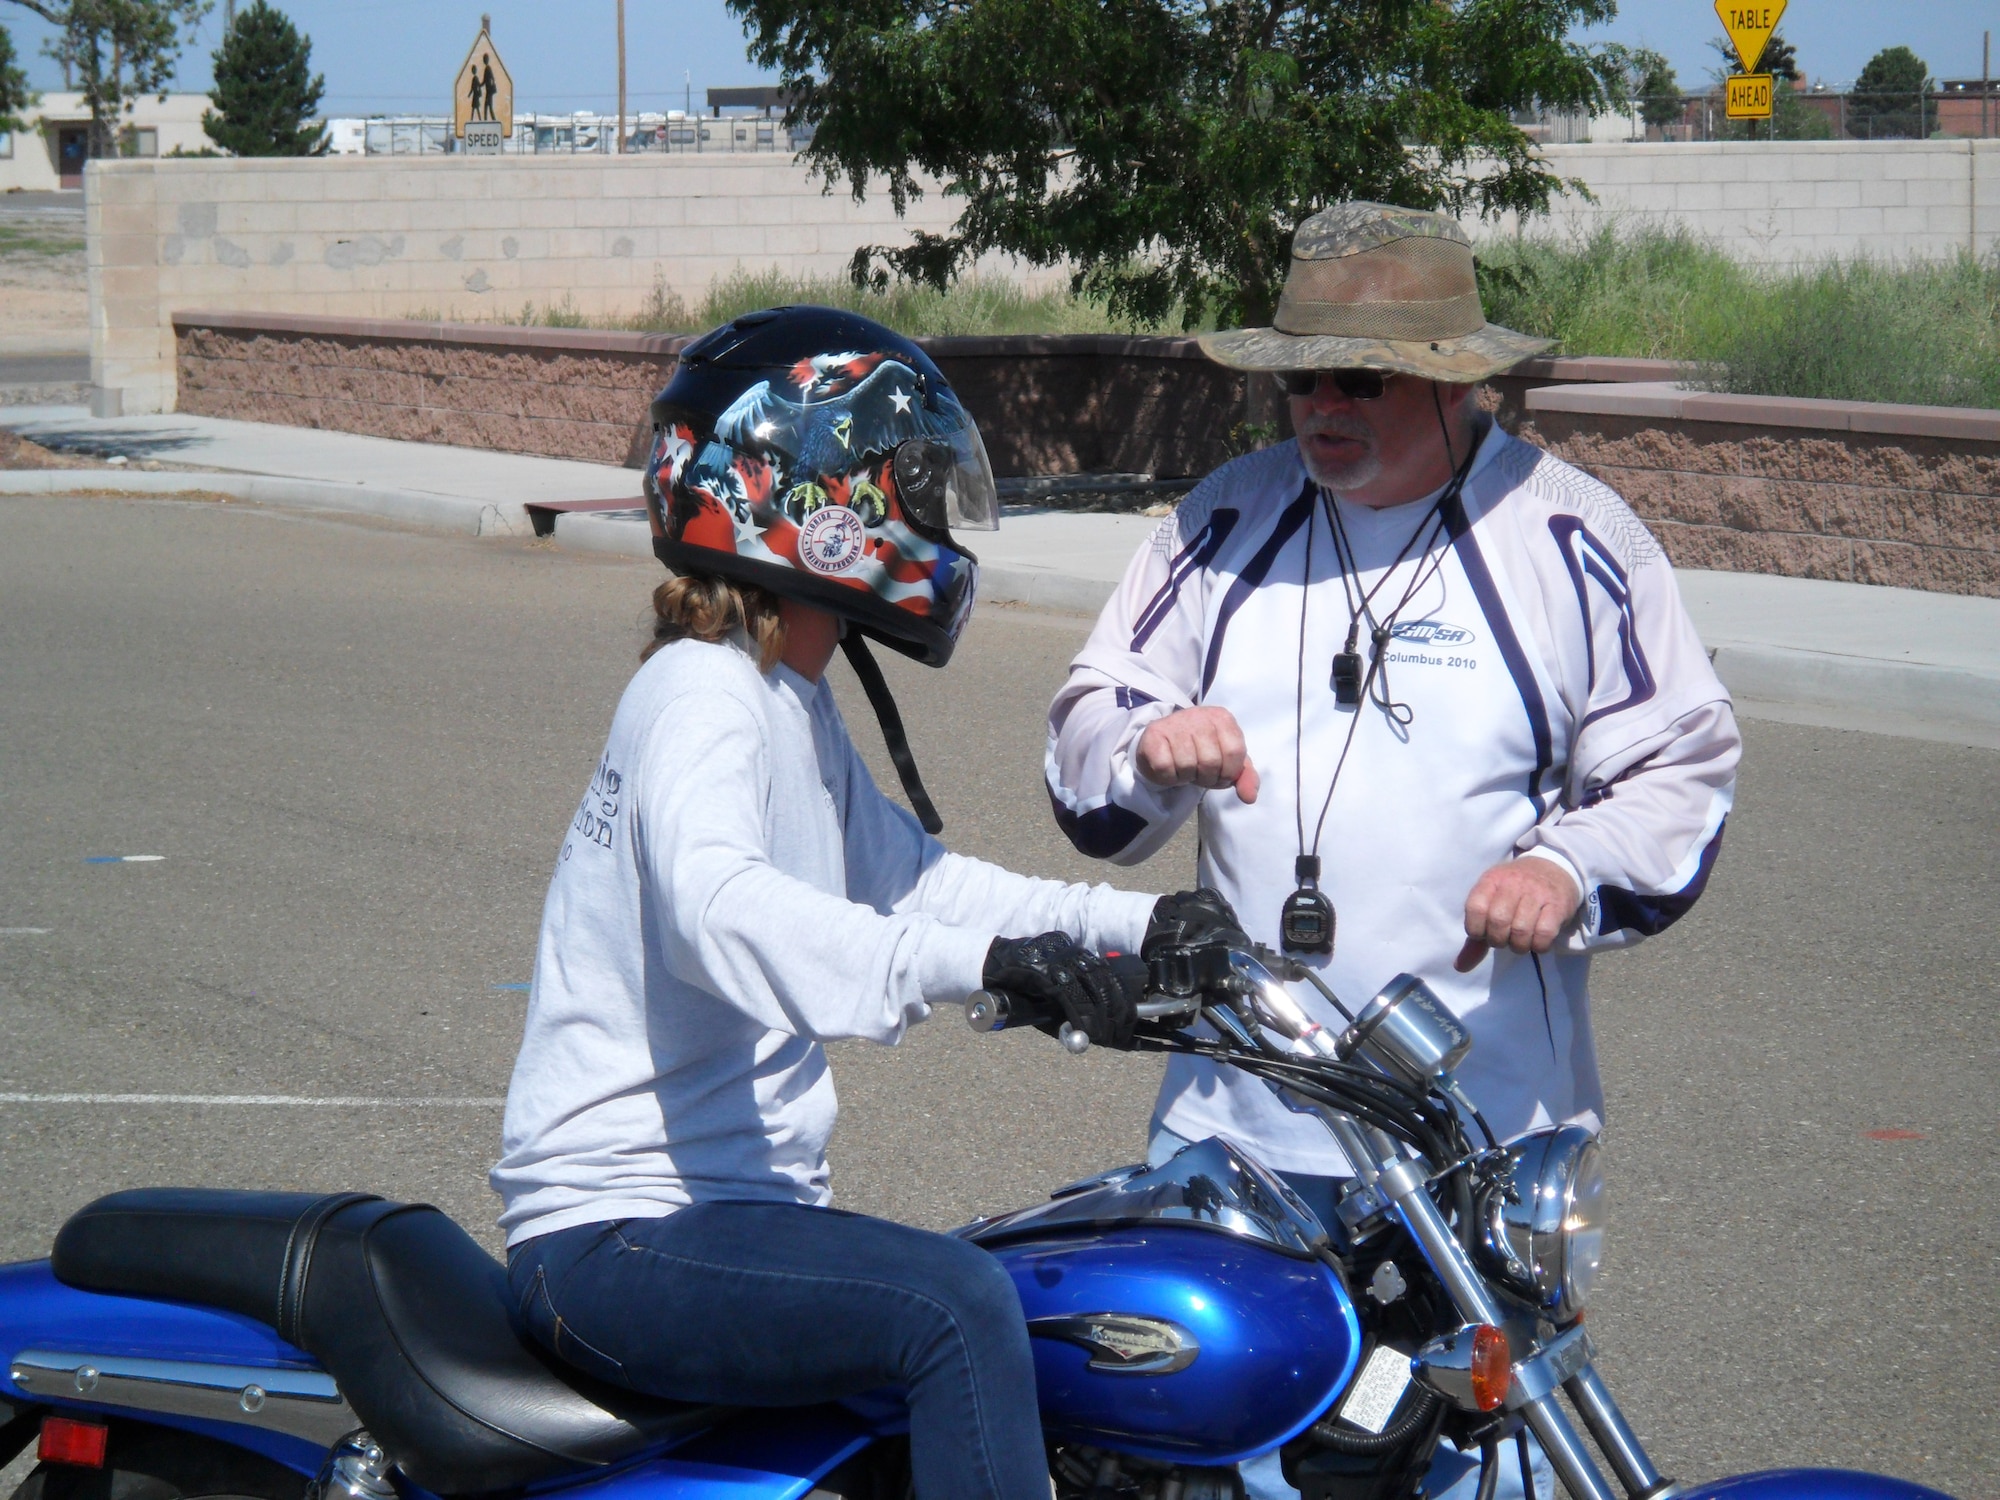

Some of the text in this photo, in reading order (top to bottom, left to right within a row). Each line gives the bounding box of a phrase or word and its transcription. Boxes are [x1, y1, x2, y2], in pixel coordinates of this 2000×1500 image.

[1730, 9, 1770, 29] TABLE
[1731, 85, 1768, 107] AHEAD
[467, 133, 499, 147] SPEED
[805, 512, 859, 537] FLORIDA RIDER
[805, 546, 859, 570] TRAINING PROGRAM
[1383, 651, 1477, 670] Columbus 2010
